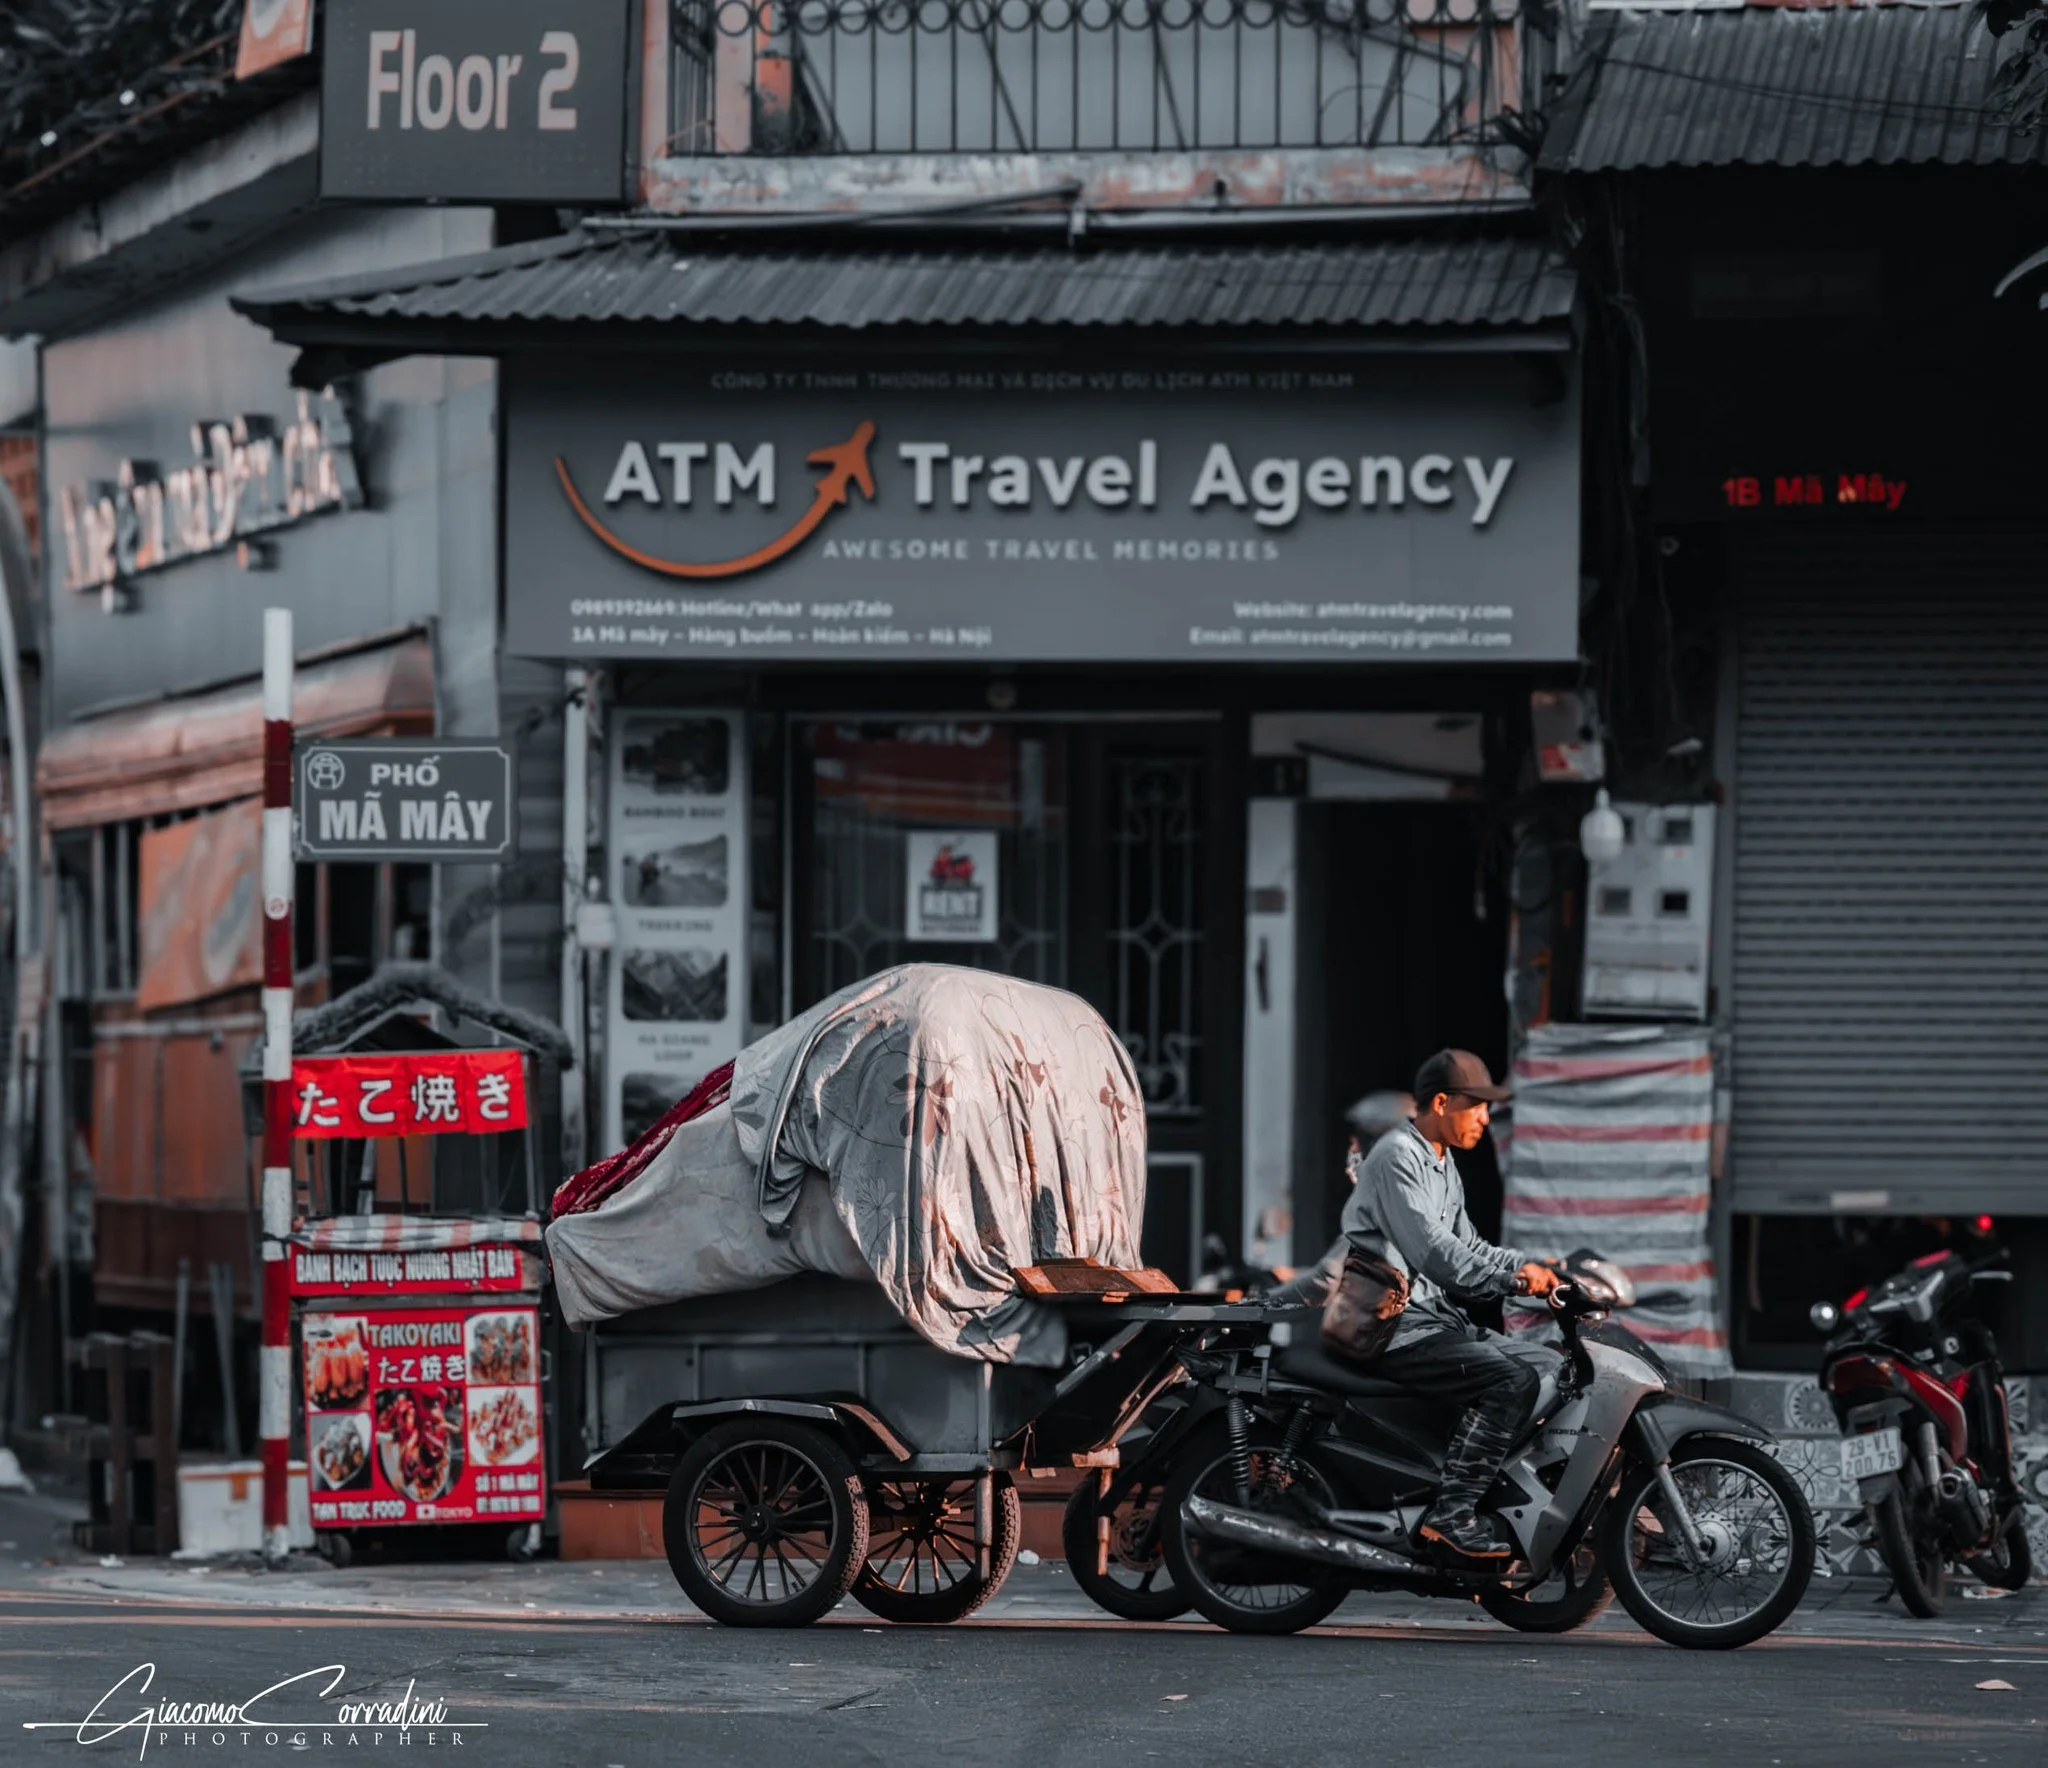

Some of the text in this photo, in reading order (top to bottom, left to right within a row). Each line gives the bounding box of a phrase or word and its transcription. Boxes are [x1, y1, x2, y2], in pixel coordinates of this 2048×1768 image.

[367, 28, 579, 130] Floor 2
[1309, 372, 1353, 388] NAM
[604, 440, 1513, 526] ATM Travel Agency
[1722, 477, 1761, 507] 1B
[823, 539, 1280, 561] AWESOME TRAVEL MEMORIES
[370, 755, 440, 786] PHỐ
[319, 791, 492, 841] MÃ MÂY
[298, 1073, 511, 1127] たこ焼き
[369, 1322, 462, 1349] TAKOYAKI
[378, 1355, 466, 1385] たこ焼き
[1848, 1433, 1889, 1458] 29-V1
[372, 1499, 406, 1520] FOOD
